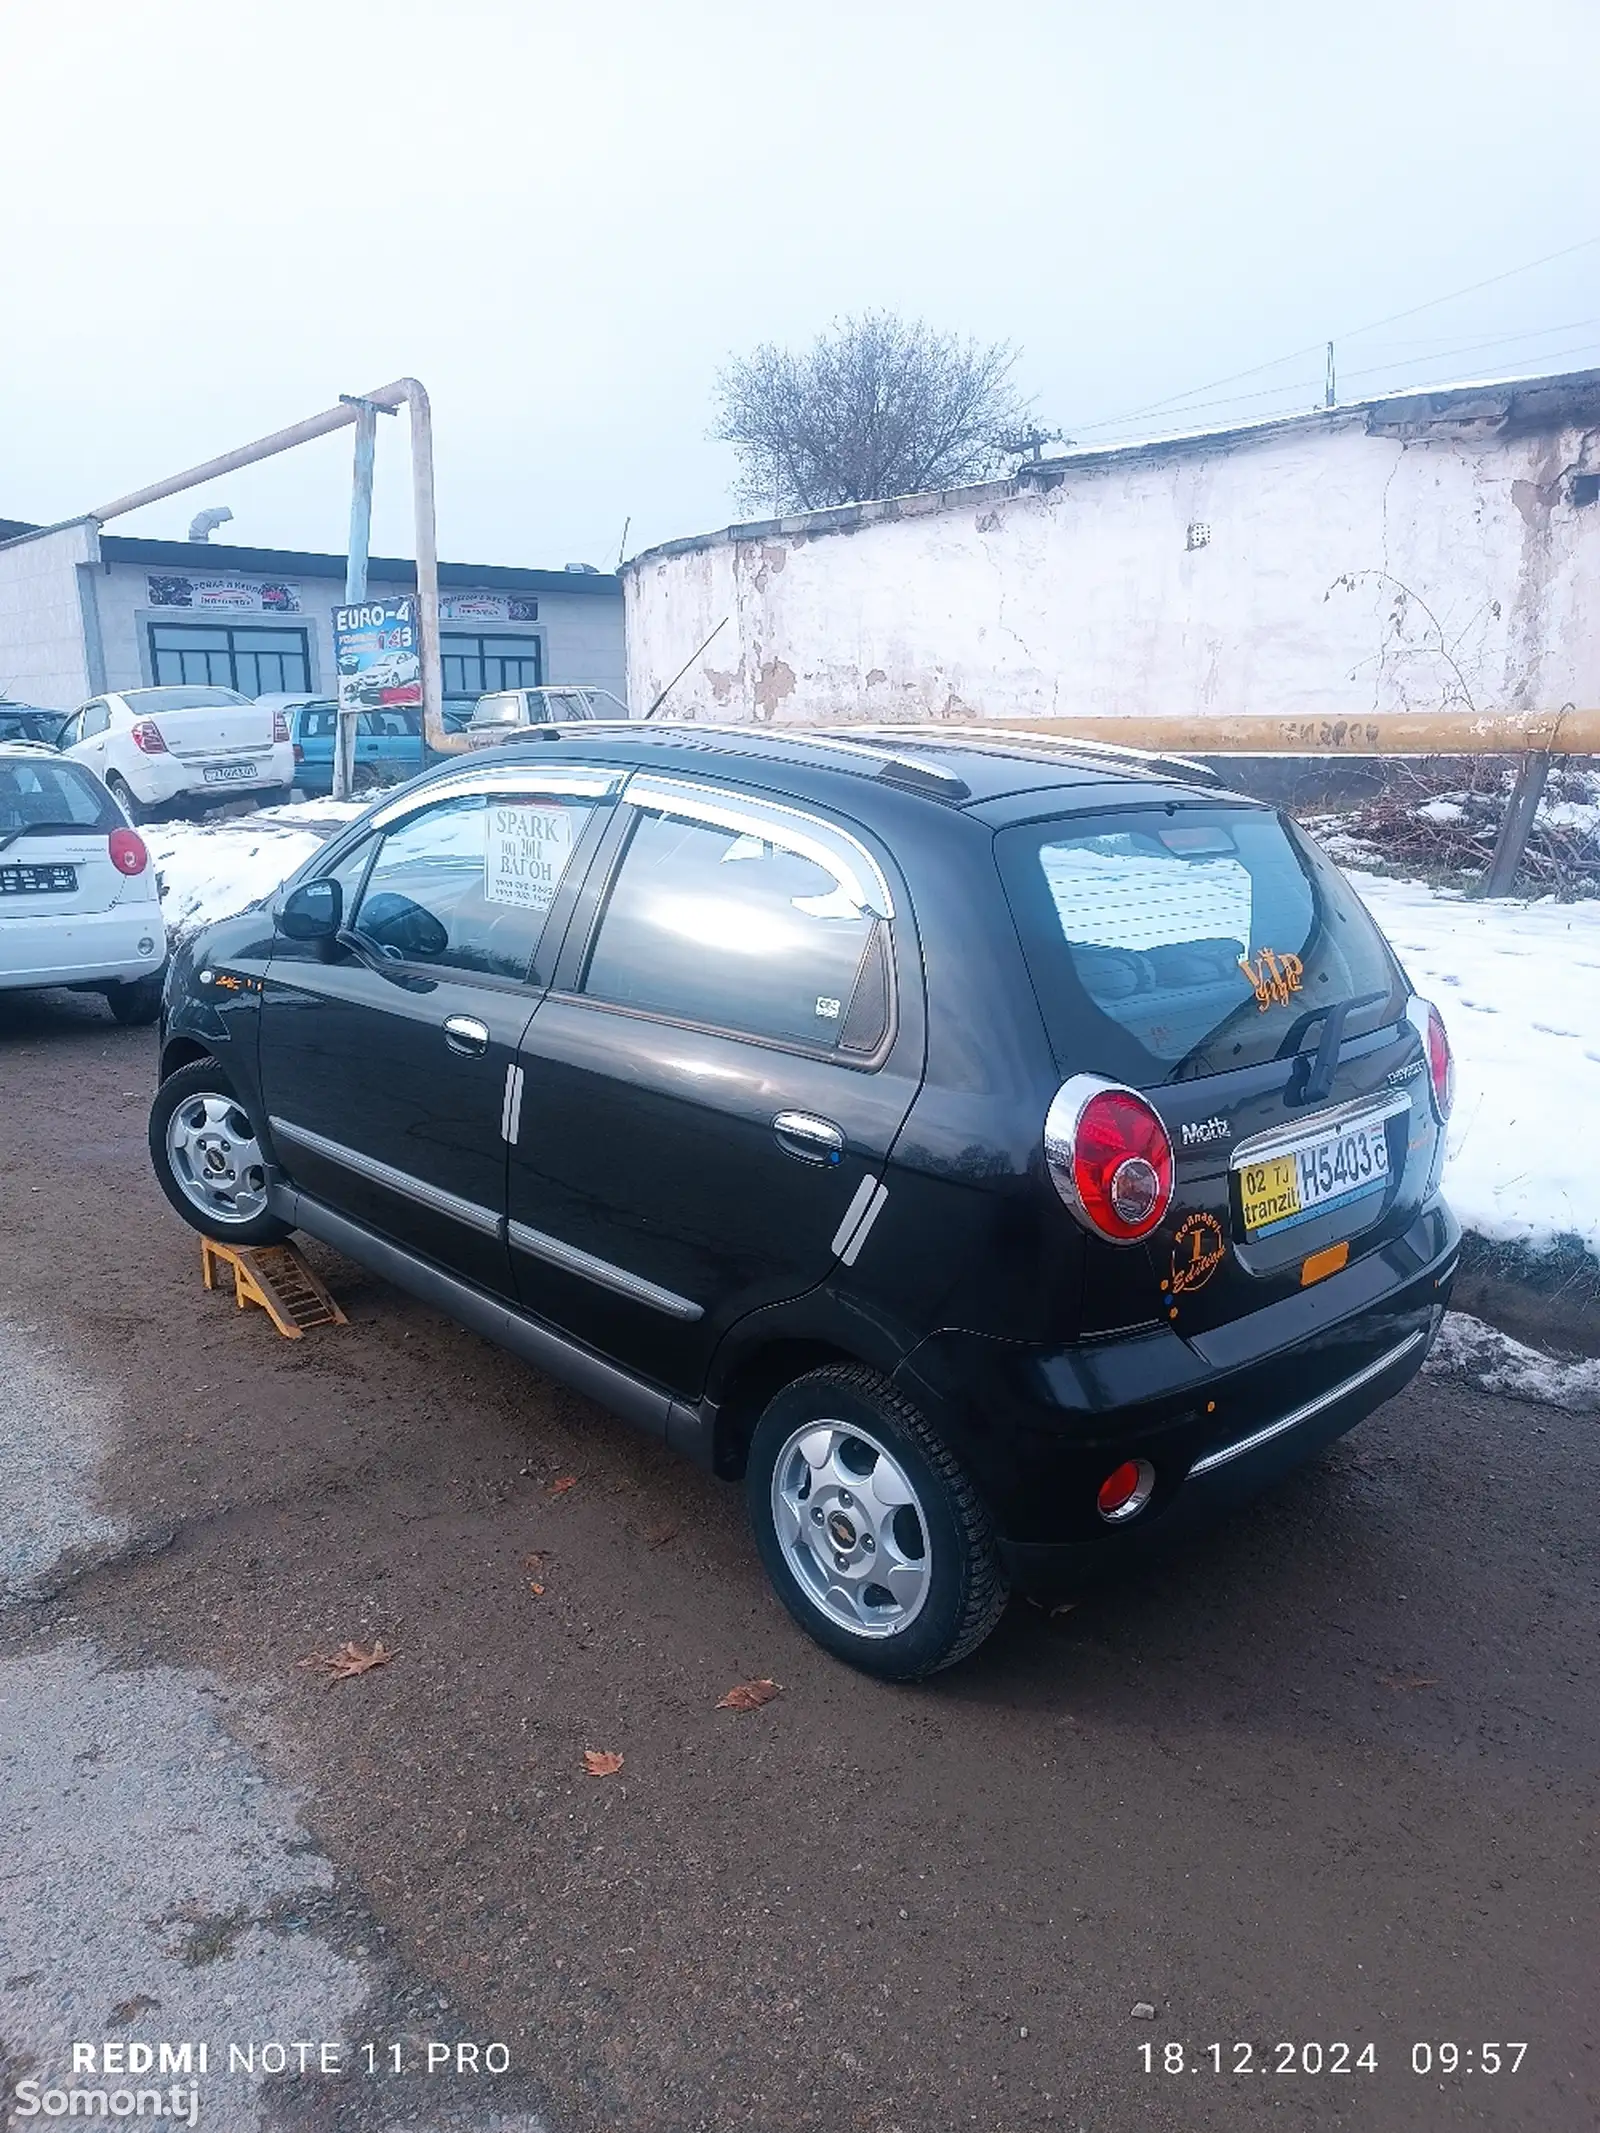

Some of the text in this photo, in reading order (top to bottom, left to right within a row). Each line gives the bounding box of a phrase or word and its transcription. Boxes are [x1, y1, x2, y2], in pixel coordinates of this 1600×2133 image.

[337, 600, 409, 632] EURO-4
[497, 809, 559, 842] SPARK
[1246, 1165, 1289, 1196] 02 TJ
[1244, 1187, 1297, 1225] tranzit
